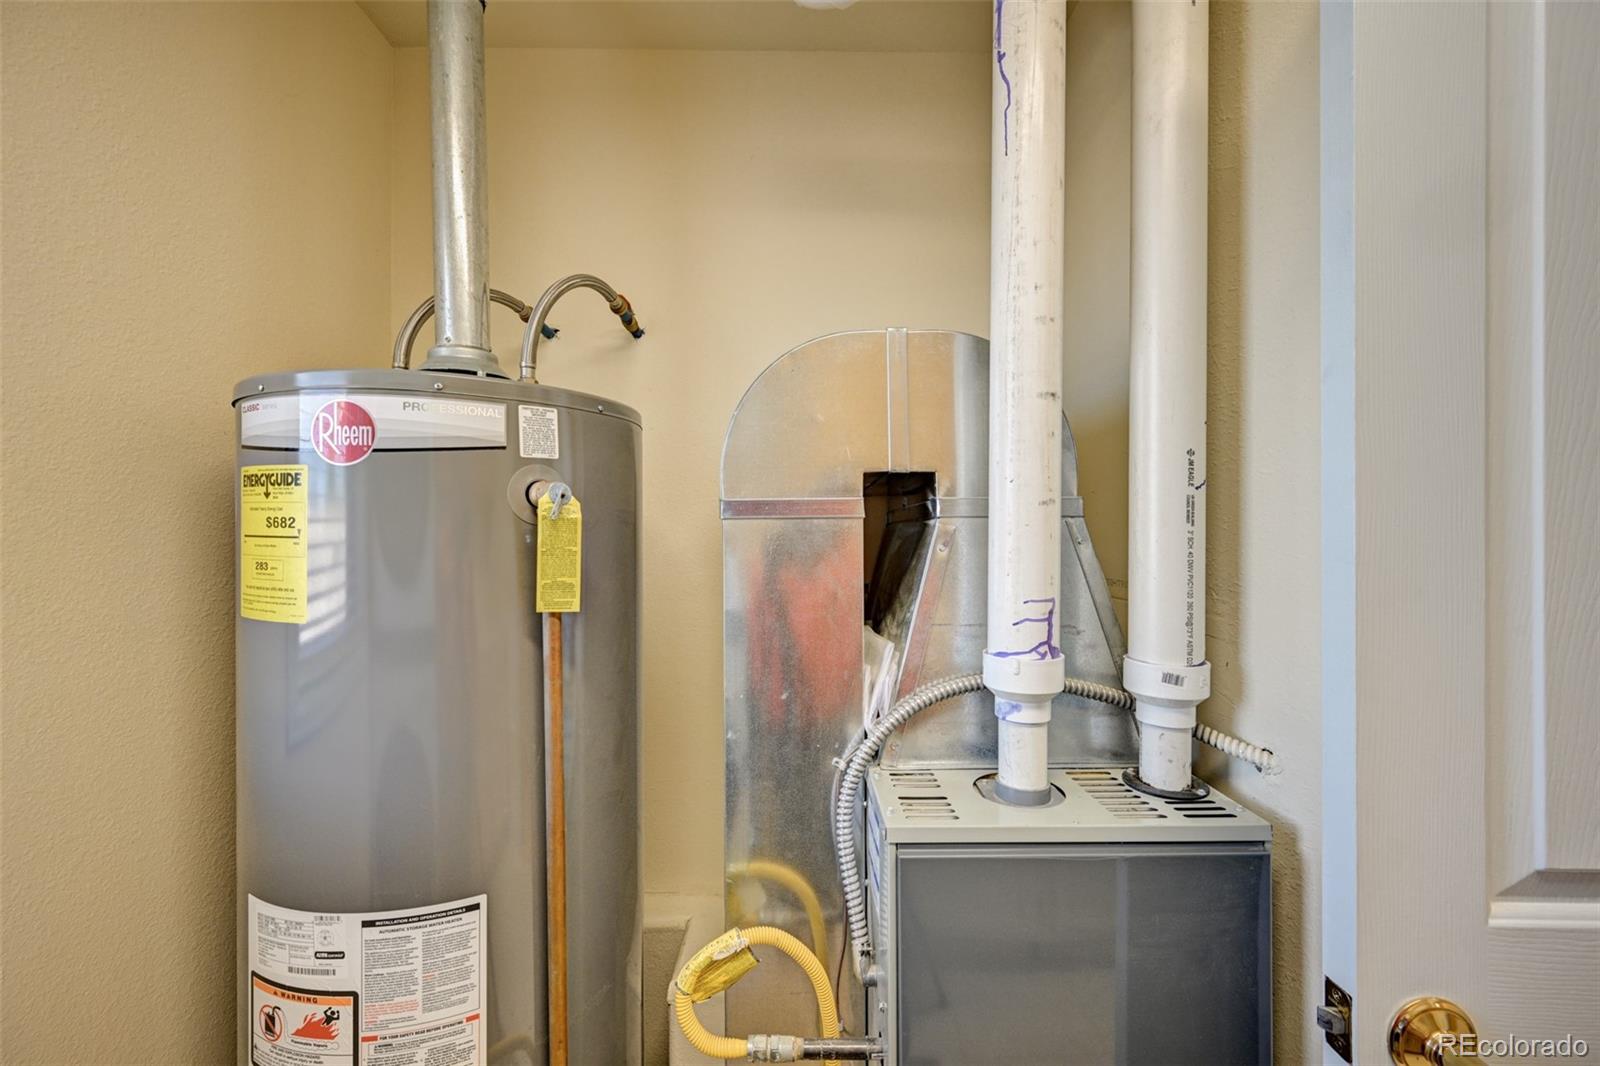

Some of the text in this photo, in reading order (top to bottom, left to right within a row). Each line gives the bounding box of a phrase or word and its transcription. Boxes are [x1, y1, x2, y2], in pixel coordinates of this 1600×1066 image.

[319, 399, 373, 455] Rheem
[243, 472, 302, 488] ENERGYGUIDE
[265, 516, 296, 529] $682
[255, 561, 269, 571] 283
[280, 991, 318, 1004] WARNING
